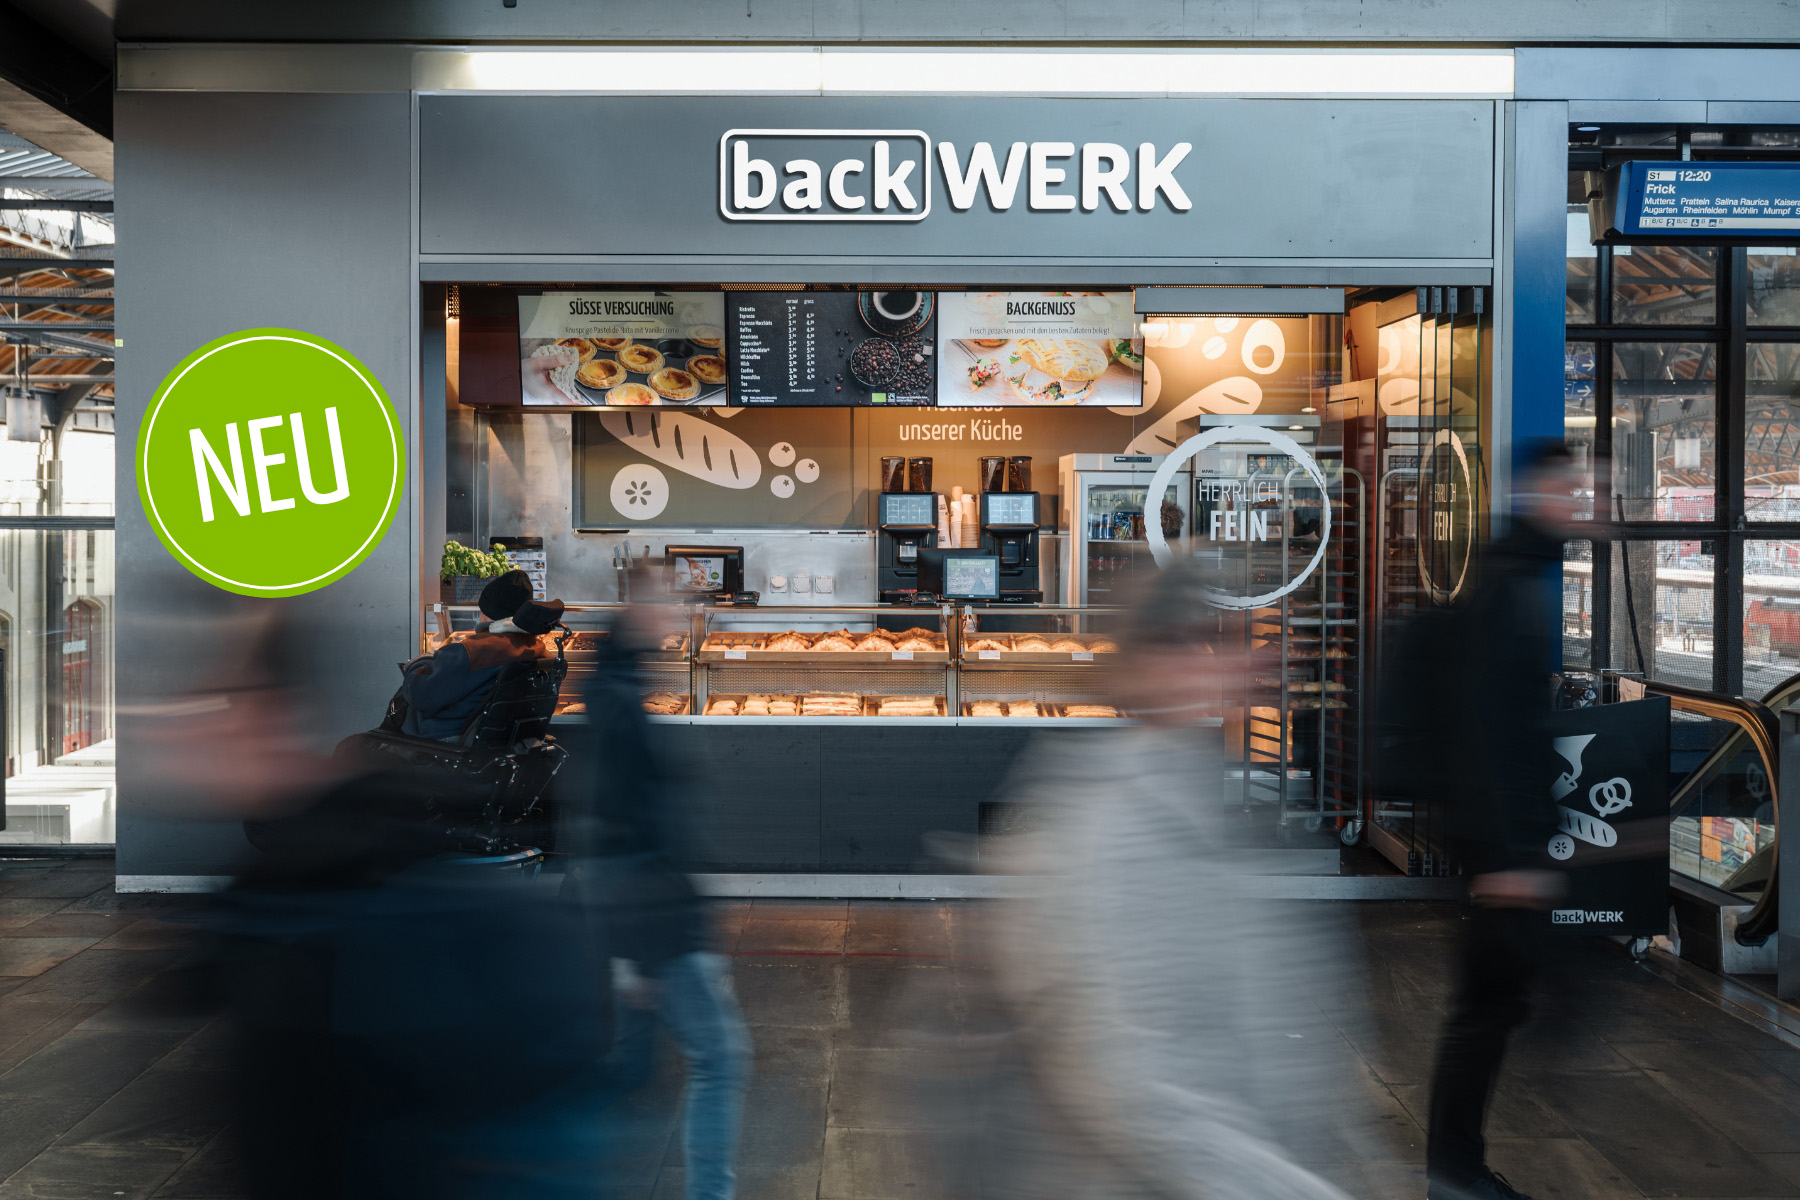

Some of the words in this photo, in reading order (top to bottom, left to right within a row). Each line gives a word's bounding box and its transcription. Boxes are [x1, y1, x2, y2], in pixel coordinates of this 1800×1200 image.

[1649, 171, 1661, 180] S1
[1678, 171, 1712, 182] 12:20
[1646, 183, 1676, 195] Frick
[1644, 197, 1676, 206] Muttenz
[1680, 197, 1710, 206] Pratteln
[1714, 197, 1739, 206] Salina
[1740, 197, 1770, 206] Raurica
[1643, 206, 1678, 216] Augarten
[1683, 206, 1728, 215] Rheinfelden
[1733, 206, 1759, 215] Möhlin
[1763, 207, 1792, 217] Mumpf
[569, 297, 602, 316] SÜSSE
[604, 300, 674, 316] VERSUCHUNG
[1006, 301, 1076, 315] BACKGENUSS
[899, 424, 967, 440] unserer
[970, 418, 1022, 440] Küche
[1199, 481, 1278, 502] HERRLICH
[1210, 510, 1267, 541] FEIN
